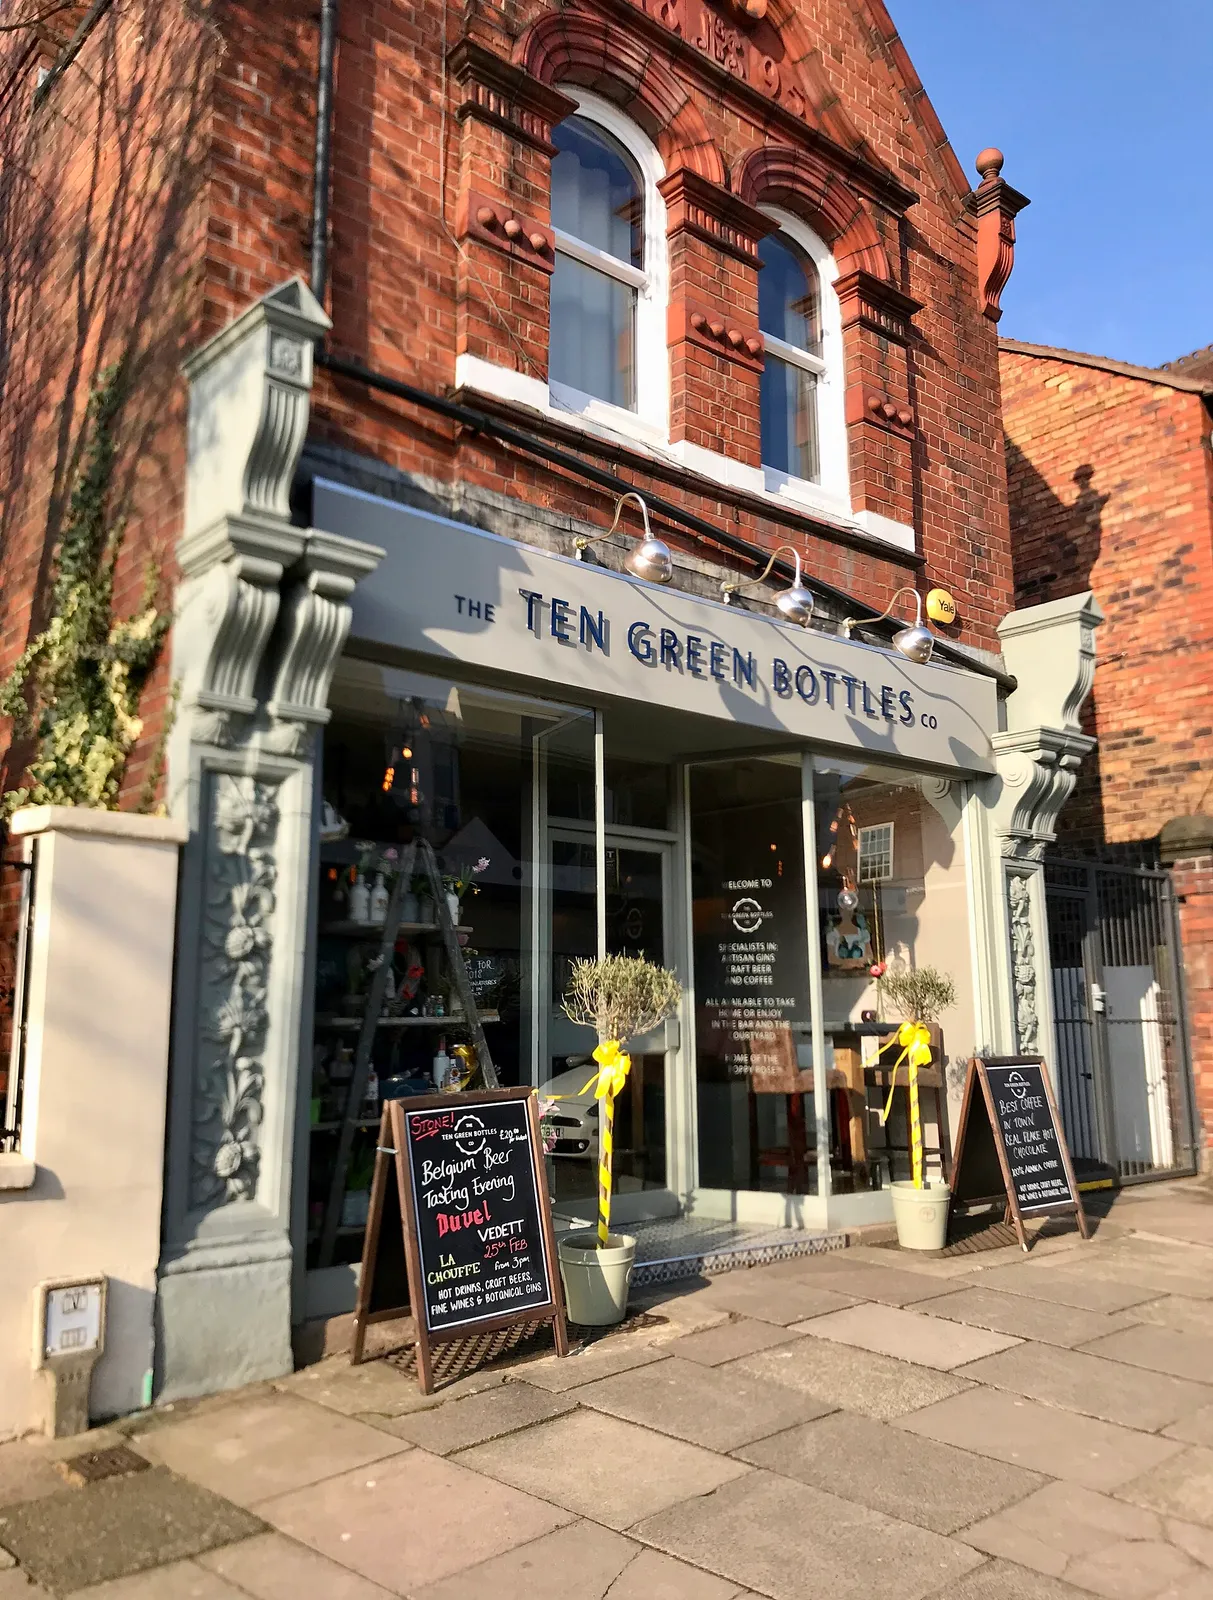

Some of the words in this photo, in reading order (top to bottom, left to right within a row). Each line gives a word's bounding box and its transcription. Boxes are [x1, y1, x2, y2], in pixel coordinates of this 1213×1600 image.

[938, 599, 955, 614] Yale
[454, 595, 496, 623] THE
[518, 588, 605, 651] TEN
[627, 622, 752, 687] GREEN
[773, 658, 912, 722] BOTTLES
[921, 713, 938, 730] CO
[760, 879, 773, 888] TO
[476, 959, 495, 969] FOR
[755, 953, 776, 963] GINS
[751, 964, 772, 974] BEER
[743, 975, 774, 985] COFFEE
[705, 998, 719, 1007] ALL
[763, 997, 775, 1007] TO
[775, 997, 796, 1007] TAKE
[743, 1009, 755, 1018] OR
[756, 1009, 782, 1018] ENJOY
[737, 1020, 754, 1029] BAR
[755, 1020, 774, 1029] AND
[774, 1020, 791, 1029] THE
[999, 1099, 1018, 1116] BEST
[1020, 1096, 1043, 1110] COFFEE
[411, 1111, 455, 1135] STONE!
[1003, 1118, 1011, 1130] IN
[1013, 1112, 1035, 1128] TOWN
[454, 1131, 473, 1140] GREEN
[474, 1128, 498, 1137] BOTTLES
[1004, 1133, 1021, 1147] REAL
[1023, 1130, 1041, 1143] FLAKE
[1042, 1127, 1054, 1141] HOT
[1013, 1142, 1048, 1159] CHOCOLATE
[421, 1157, 477, 1191] Belgium
[483, 1147, 513, 1173] Beer
[422, 1186, 470, 1211] Tasting
[471, 1175, 515, 1202] Evening
[436, 1200, 492, 1238] Duvel
[477, 1219, 525, 1242] VEDETT
[509, 1237, 528, 1253] FEB
[439, 1253, 456, 1267] LA
[512, 1255, 530, 1269] 3pm
[428, 1262, 481, 1284] CHOUFFE
[438, 1287, 453, 1300] HOT
[485, 1276, 507, 1290] CRAFT
[431, 1302, 448, 1316] FINE
[450, 1297, 475, 1311] WINES
[477, 1295, 483, 1305] &
[485, 1286, 524, 1304] BOTANICAL
[526, 1281, 542, 1294] GINS
